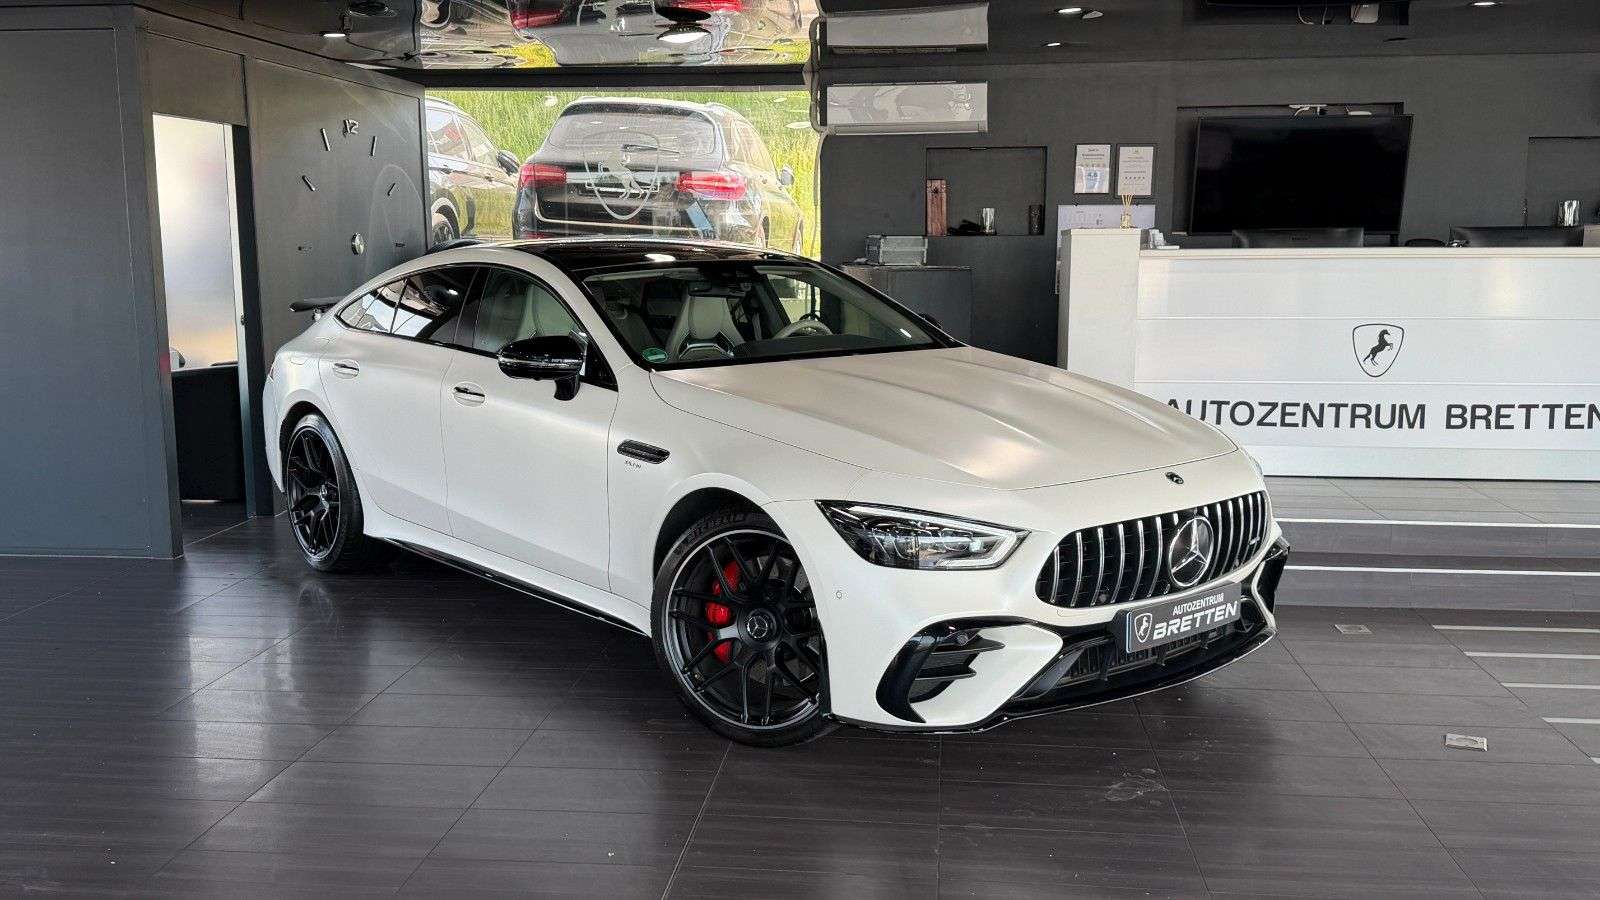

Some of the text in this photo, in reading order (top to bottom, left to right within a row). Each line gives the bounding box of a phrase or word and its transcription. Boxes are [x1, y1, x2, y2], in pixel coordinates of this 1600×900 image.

[345, 119, 359, 134] 12
[1446, 403, 1600, 430] BRETTEN
[1172, 592, 1225, 616] AUTOZENTRUM
[1152, 600, 1238, 640] BRETTEN
